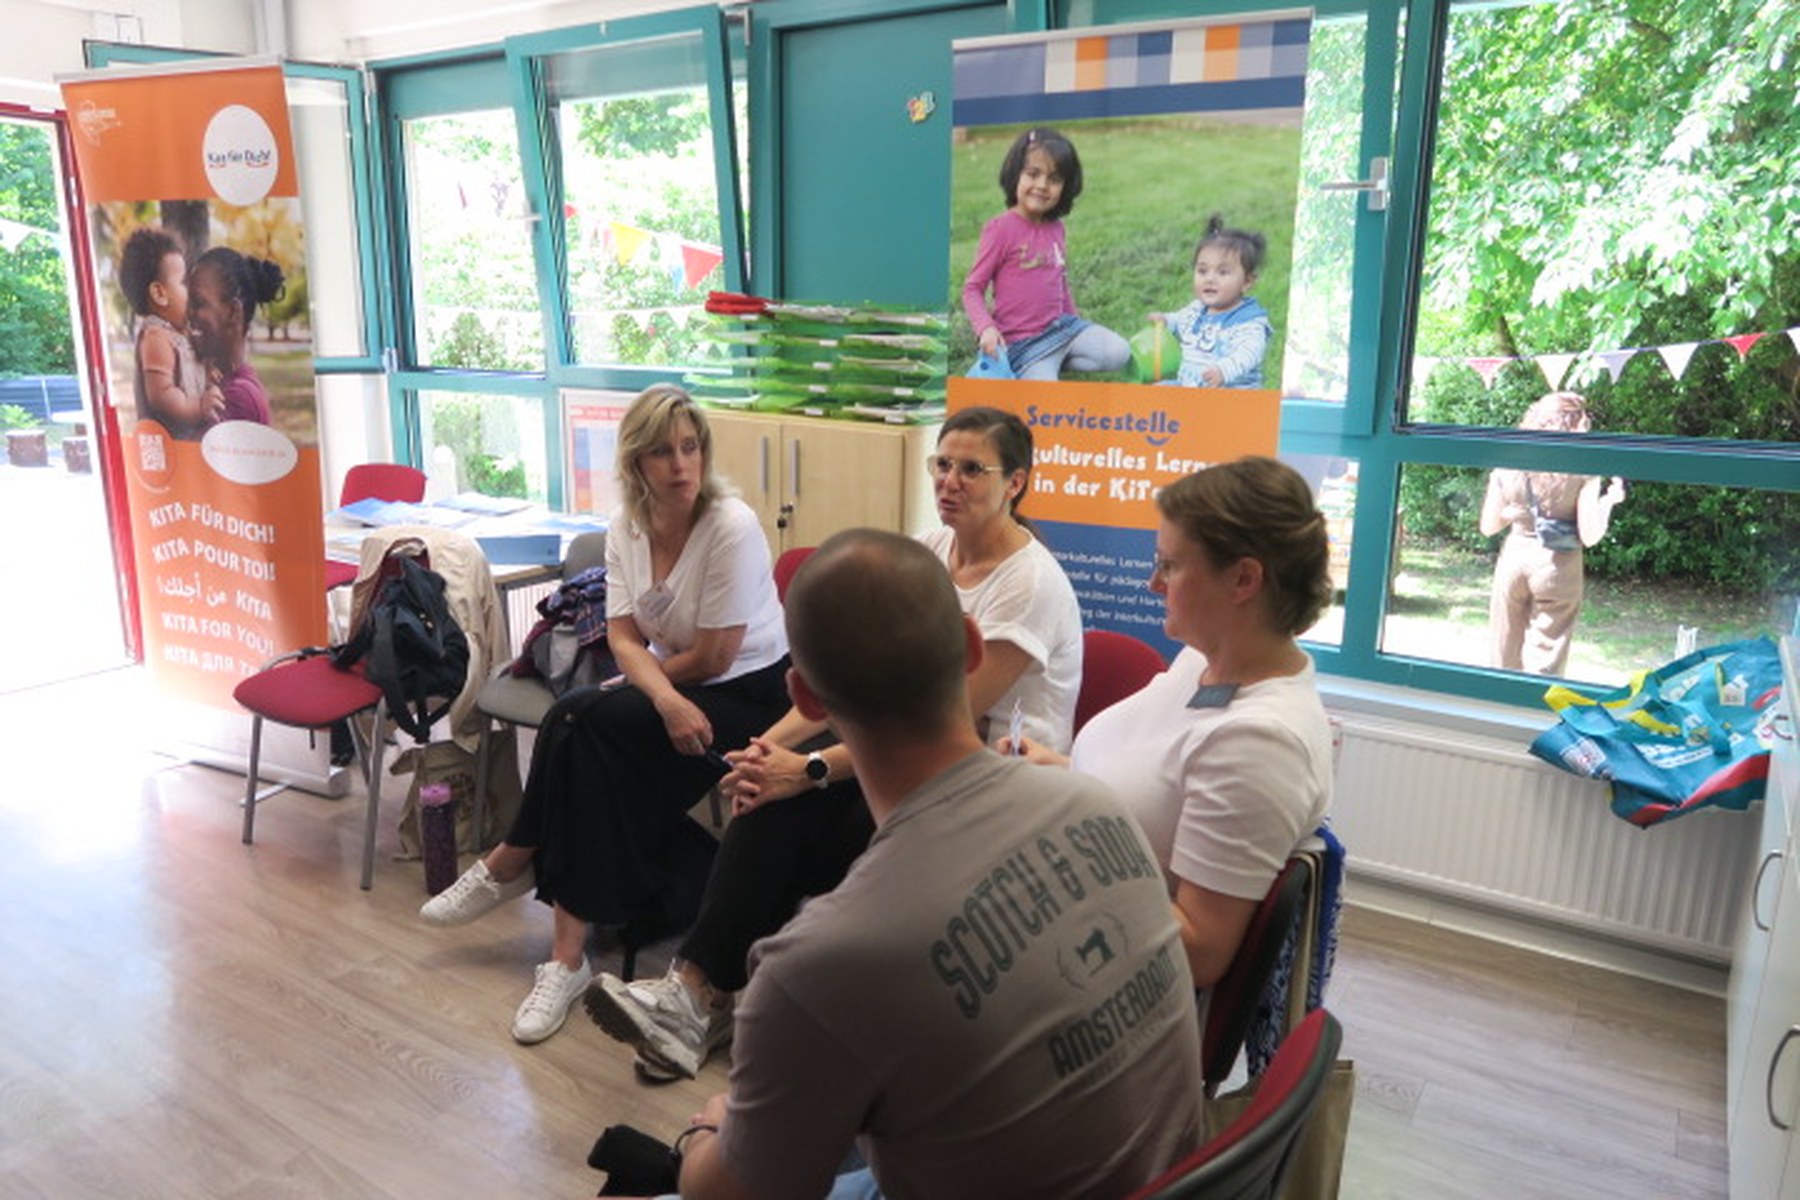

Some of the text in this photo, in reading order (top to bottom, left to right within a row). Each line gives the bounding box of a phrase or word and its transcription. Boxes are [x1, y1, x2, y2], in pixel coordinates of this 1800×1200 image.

[1027, 405, 1180, 434] Servicestelle
[1156, 452, 1218, 474] Lern
[1034, 473, 1055, 493] in
[1063, 475, 1100, 496] der
[150, 502, 275, 543] KITA FÜR DICH!
[153, 538, 276, 580] KITA POUR TOI!
[236, 589, 273, 621] KITA
[162, 612, 274, 657] KITA FOR YOU!
[930, 851, 1062, 1020] SCOTCH
[1064, 815, 1158, 886] SODA
[1048, 945, 1178, 1079] AMSTERDAM
